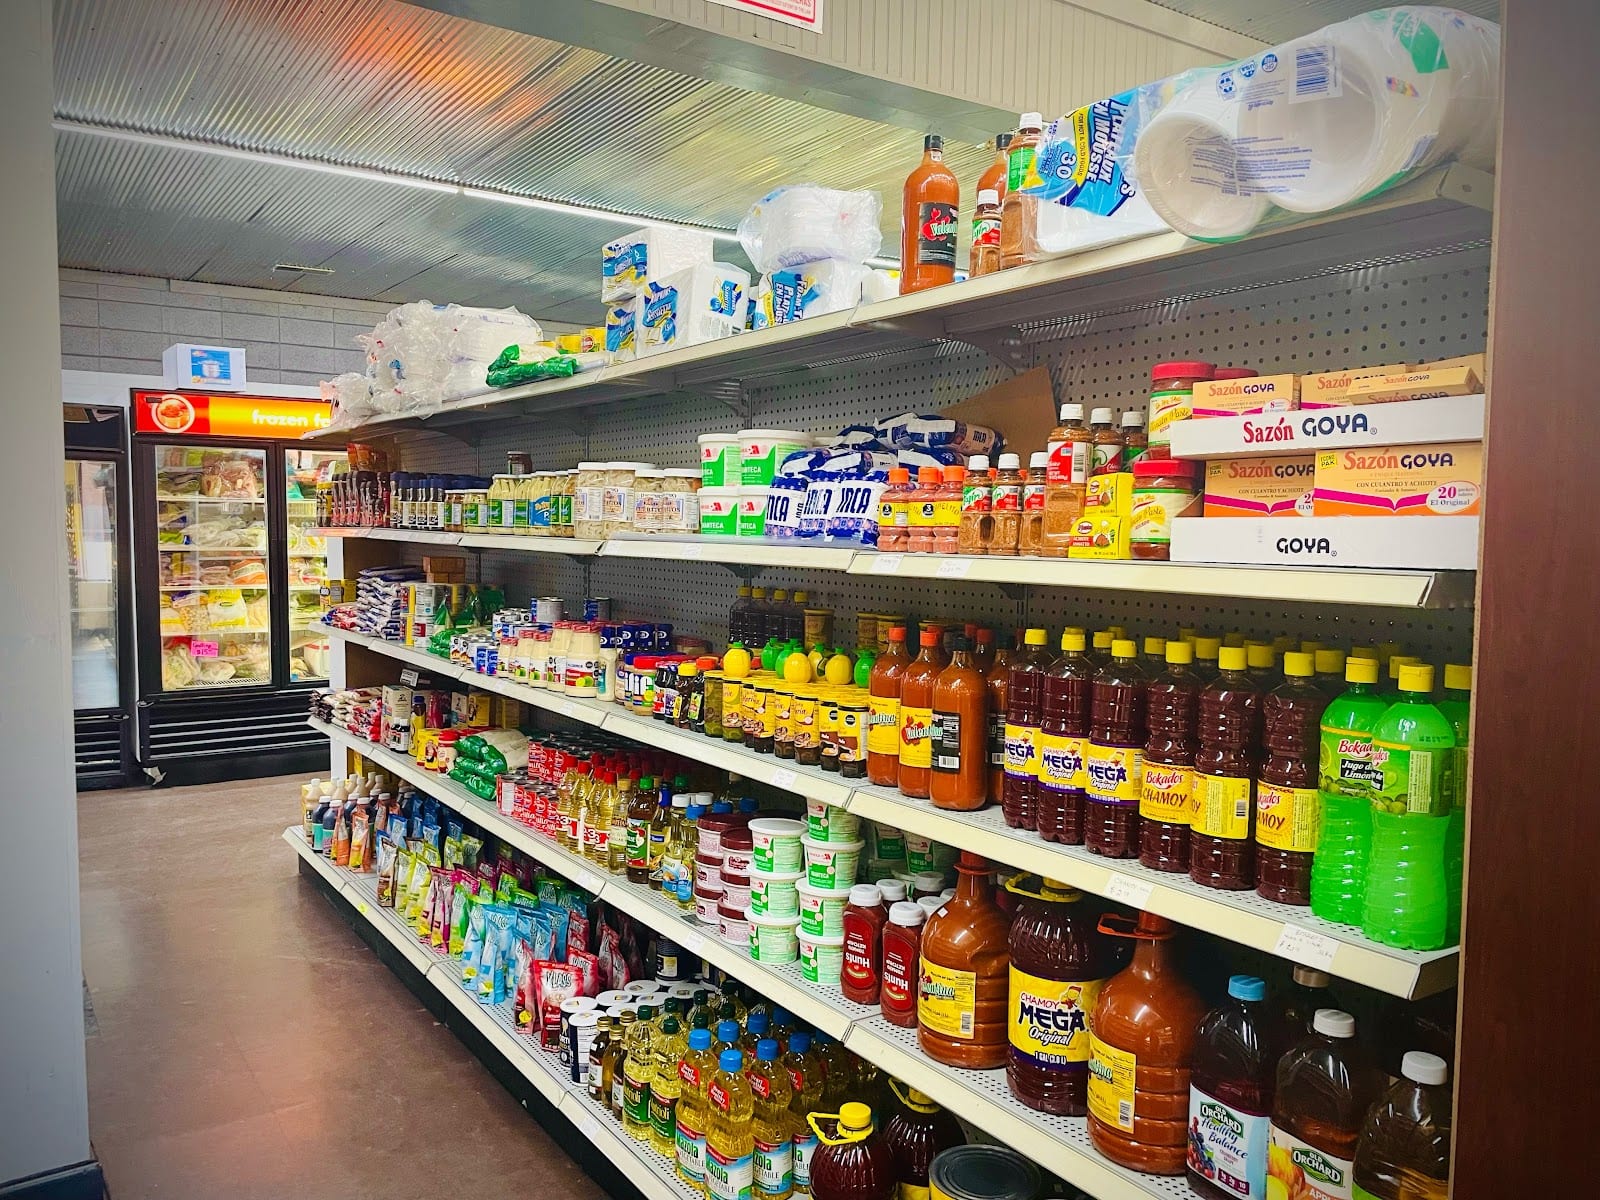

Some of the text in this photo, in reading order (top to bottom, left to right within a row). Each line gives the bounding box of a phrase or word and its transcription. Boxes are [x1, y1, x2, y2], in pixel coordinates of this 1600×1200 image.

[1085, 117, 1111, 184] MOUSSE
[1097, 99, 1130, 185] PLATEAUX
[1056, 151, 1077, 180] 30
[1317, 373, 1352, 390] Sazón
[1384, 374, 1430, 385] Sazón GOYA
[1209, 382, 1275, 397] Sazón GOYA
[252, 409, 331, 427] frozen fo
[1243, 413, 1368, 444] Sazón GOYA
[1343, 448, 1453, 470] Sazón GOYA
[1228, 460, 1315, 479] Sazón GOYA
[1437, 486, 1457, 499] 20
[1276, 537, 1330, 554] GOYA
[1041, 753, 1083, 772] MEGA
[1341, 760, 1364, 770] Jugo
[1088, 764, 1127, 783] MEGA
[1146, 770, 1184, 787] Bokados
[1142, 787, 1188, 808] CHAMOY
[1020, 992, 1060, 1009] CHAMOY
[1018, 1001, 1086, 1032] MEGA
[1029, 1025, 1074, 1047] Original
[1201, 1104, 1242, 1134] ORCHARD
[1215, 1104, 1227, 1115] OLD
[1201, 1117, 1239, 1144] Healthy
[1208, 1132, 1249, 1158] Balance
[1293, 1150, 1341, 1182] ORCHARD
[1309, 1151, 1322, 1162] OLD
